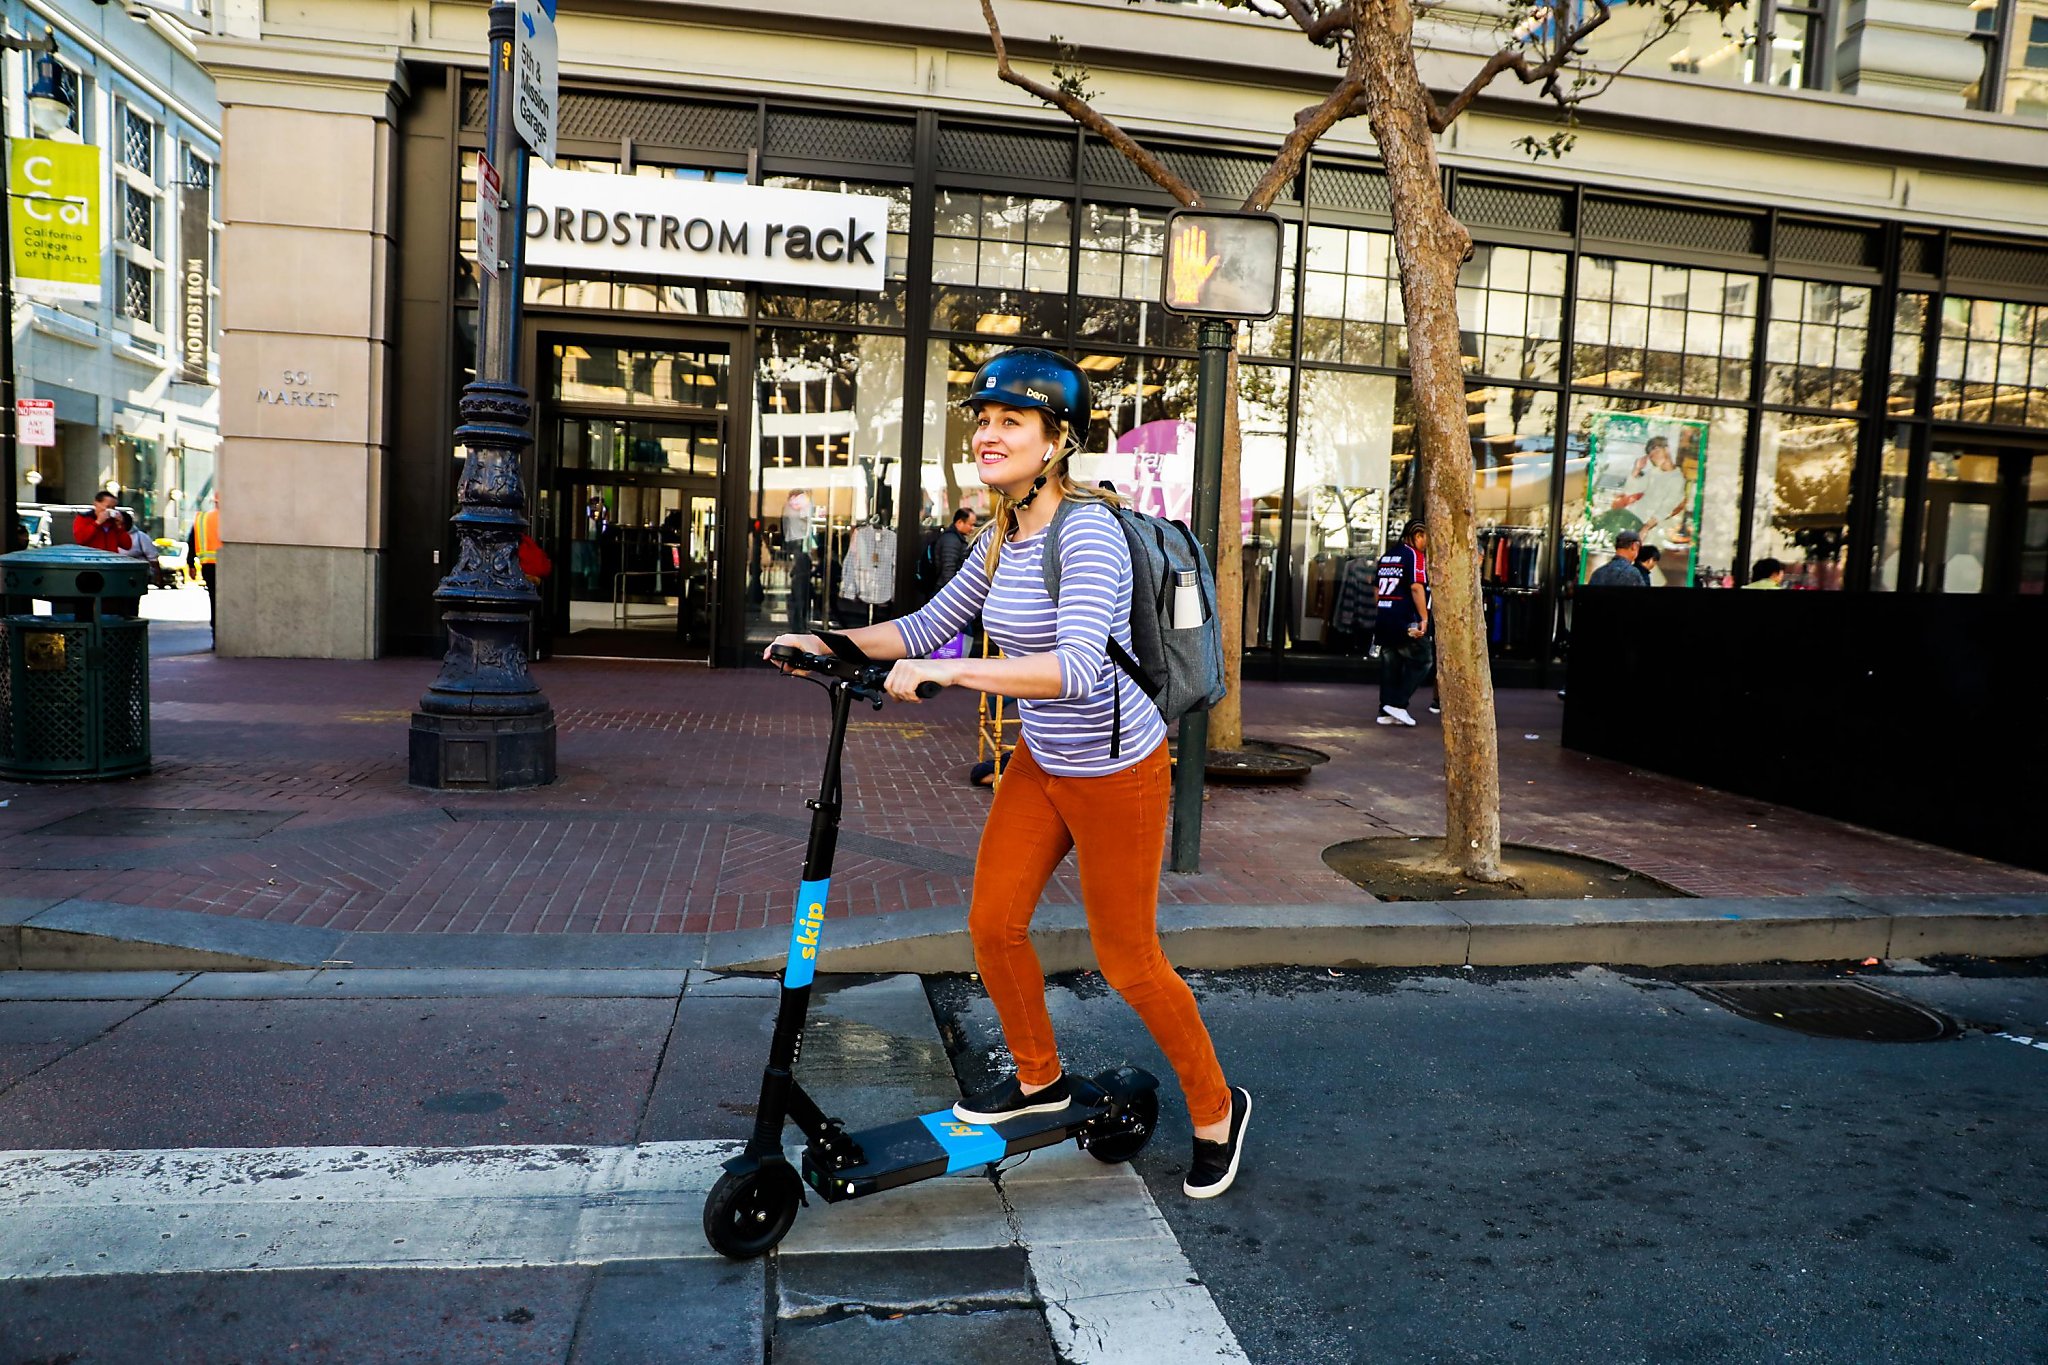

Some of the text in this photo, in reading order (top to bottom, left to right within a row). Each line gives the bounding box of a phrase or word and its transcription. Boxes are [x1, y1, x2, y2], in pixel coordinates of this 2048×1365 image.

[521, 42, 542, 84] 5th &
[521, 68, 549, 120] Mission
[520, 96, 547, 143] Garage
[24, 226, 82, 241] California
[24, 238, 68, 251] College
[525, 203, 876, 265] ORDSTROM rack
[42, 251, 60, 261] the
[64, 254, 87, 264] Arts
[187, 258, 204, 365] NORDSTROM
[257, 387, 340, 408] MARKET
[796, 902, 825, 960] skip
